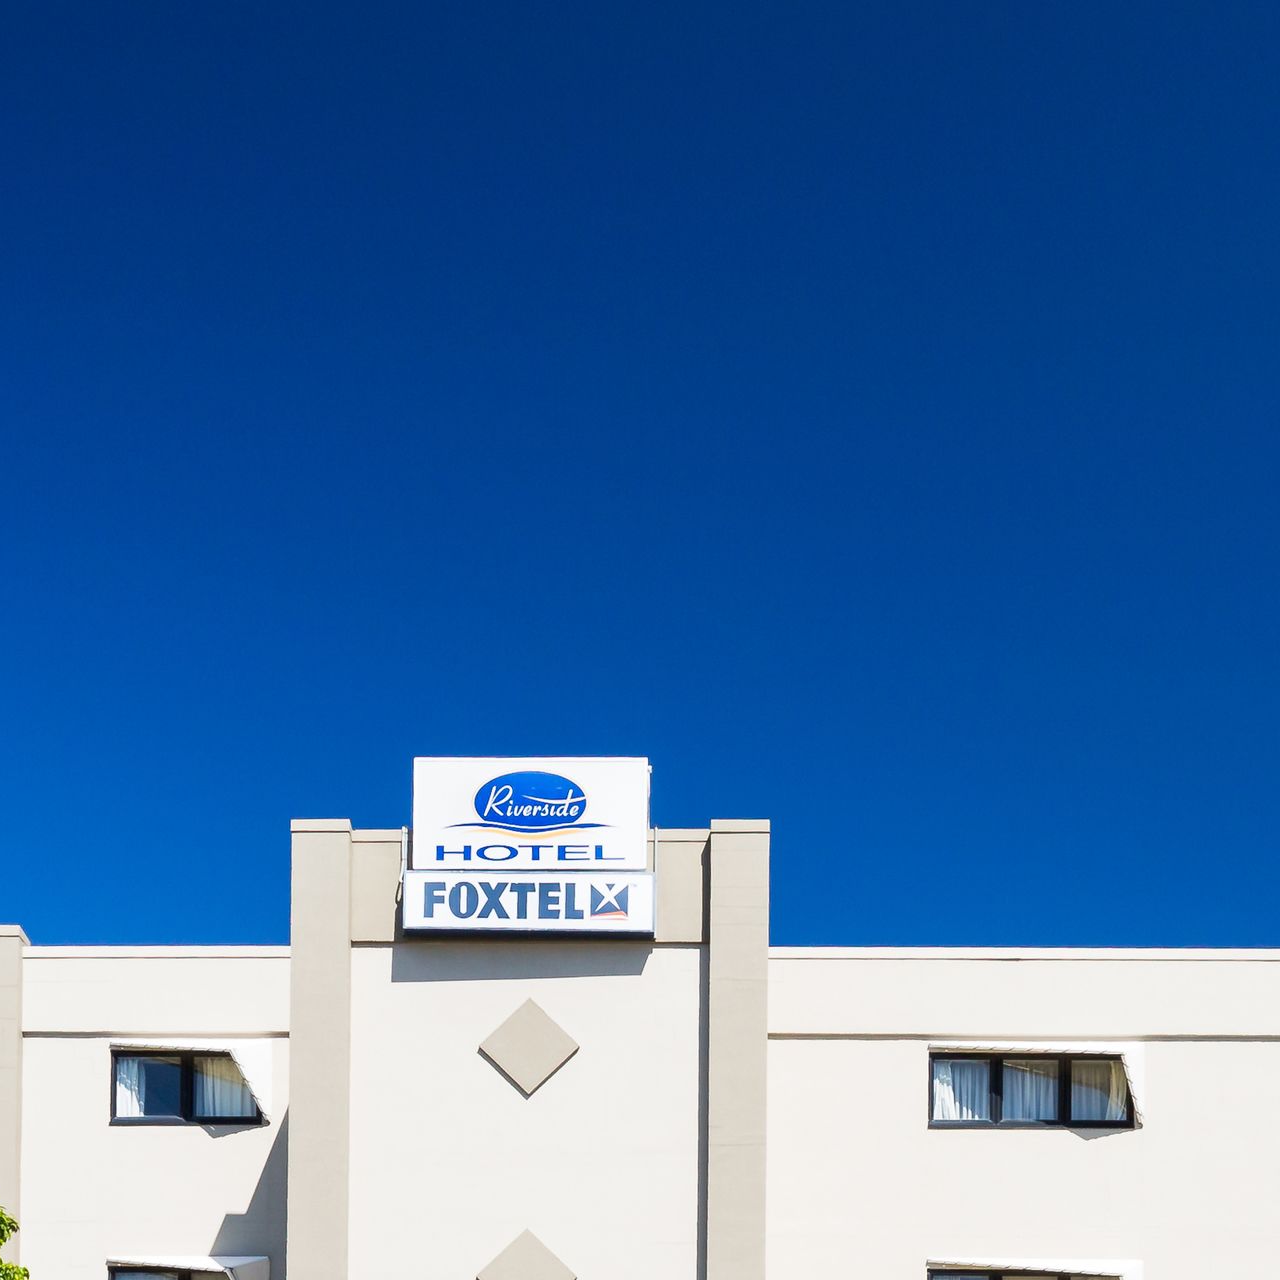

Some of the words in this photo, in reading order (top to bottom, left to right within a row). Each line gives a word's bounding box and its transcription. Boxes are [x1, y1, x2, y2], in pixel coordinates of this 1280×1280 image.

[484, 785, 587, 818] Riverside
[436, 845, 625, 861] HOTEL
[423, 881, 584, 920] FOXTEL
